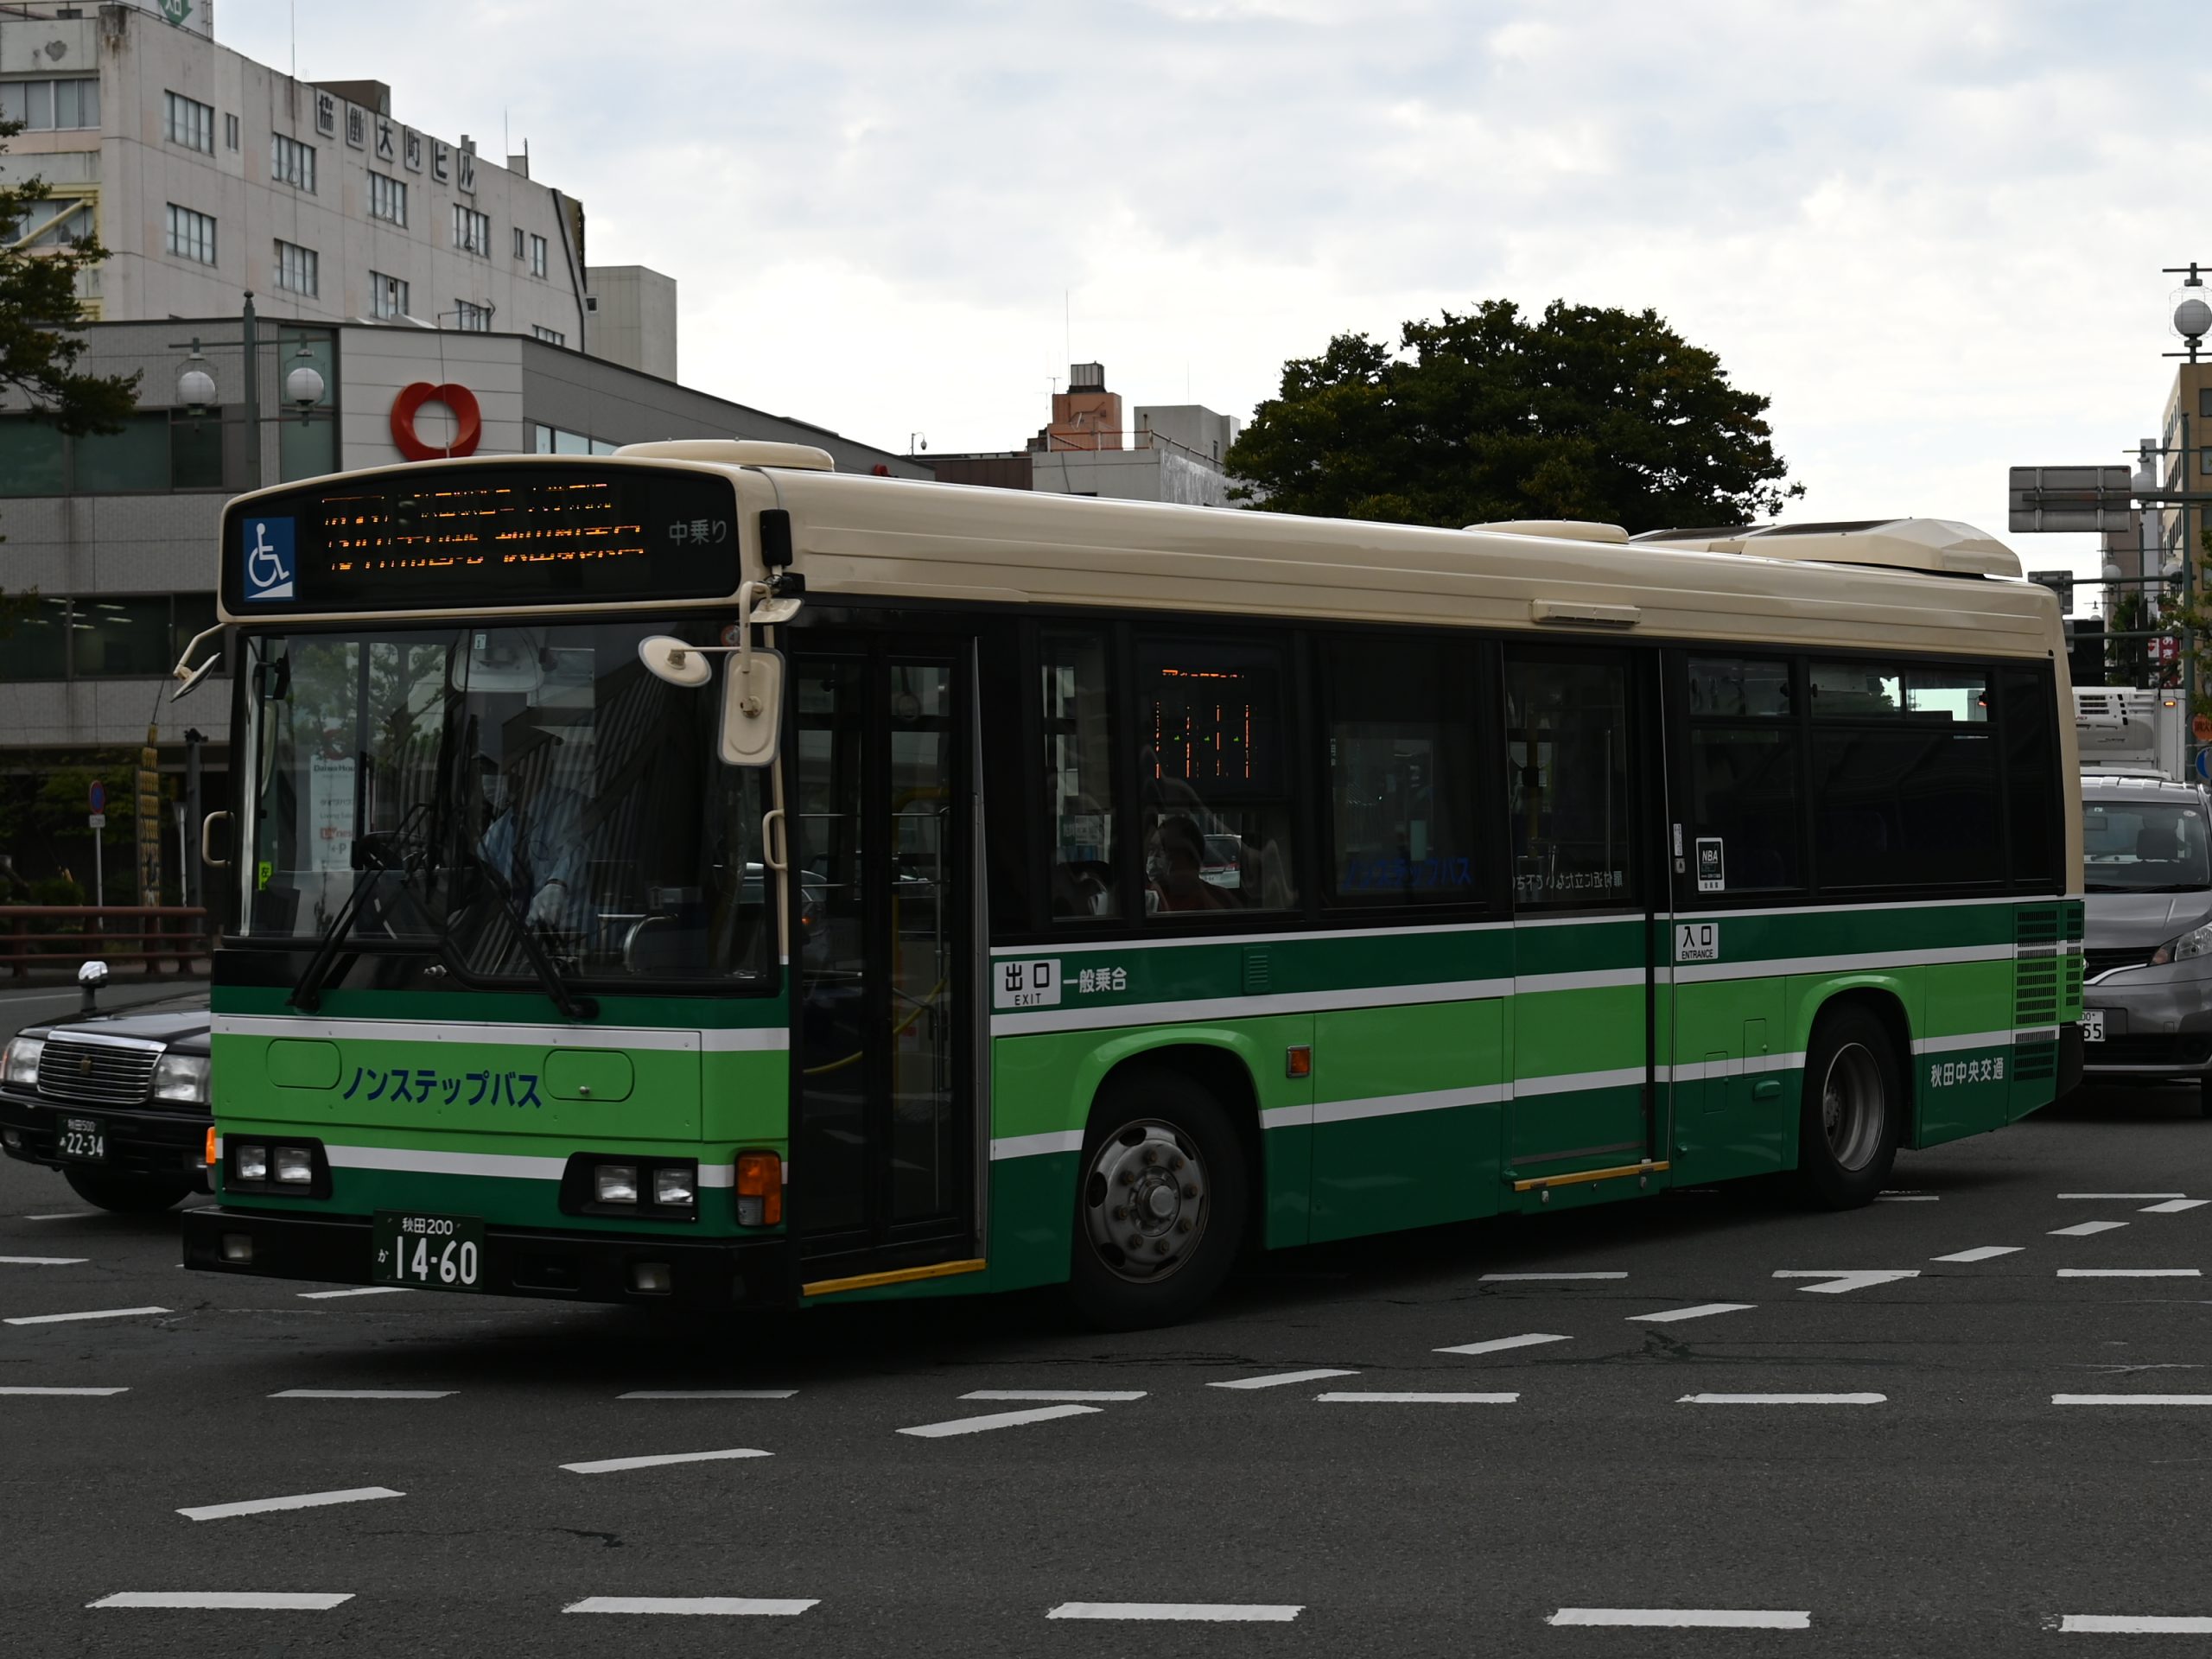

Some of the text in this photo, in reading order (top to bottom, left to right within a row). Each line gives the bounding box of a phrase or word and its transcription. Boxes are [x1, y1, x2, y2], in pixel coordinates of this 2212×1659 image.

[668, 518, 728, 546] 中乗り
[1683, 925, 1712, 948] 入口
[1681, 949, 1713, 960] ENTRANCE
[1005, 963, 1051, 992] 出口
[1063, 966, 1128, 994] 一般乗合
[1014, 993, 1042, 1006] EXIT
[1930, 1057, 2005, 1088] 秋田中央交通
[342, 1066, 543, 1109] ノンステップバス
[402, 1217, 454, 1236] 秋田200
[377, 1249, 390, 1264] か
